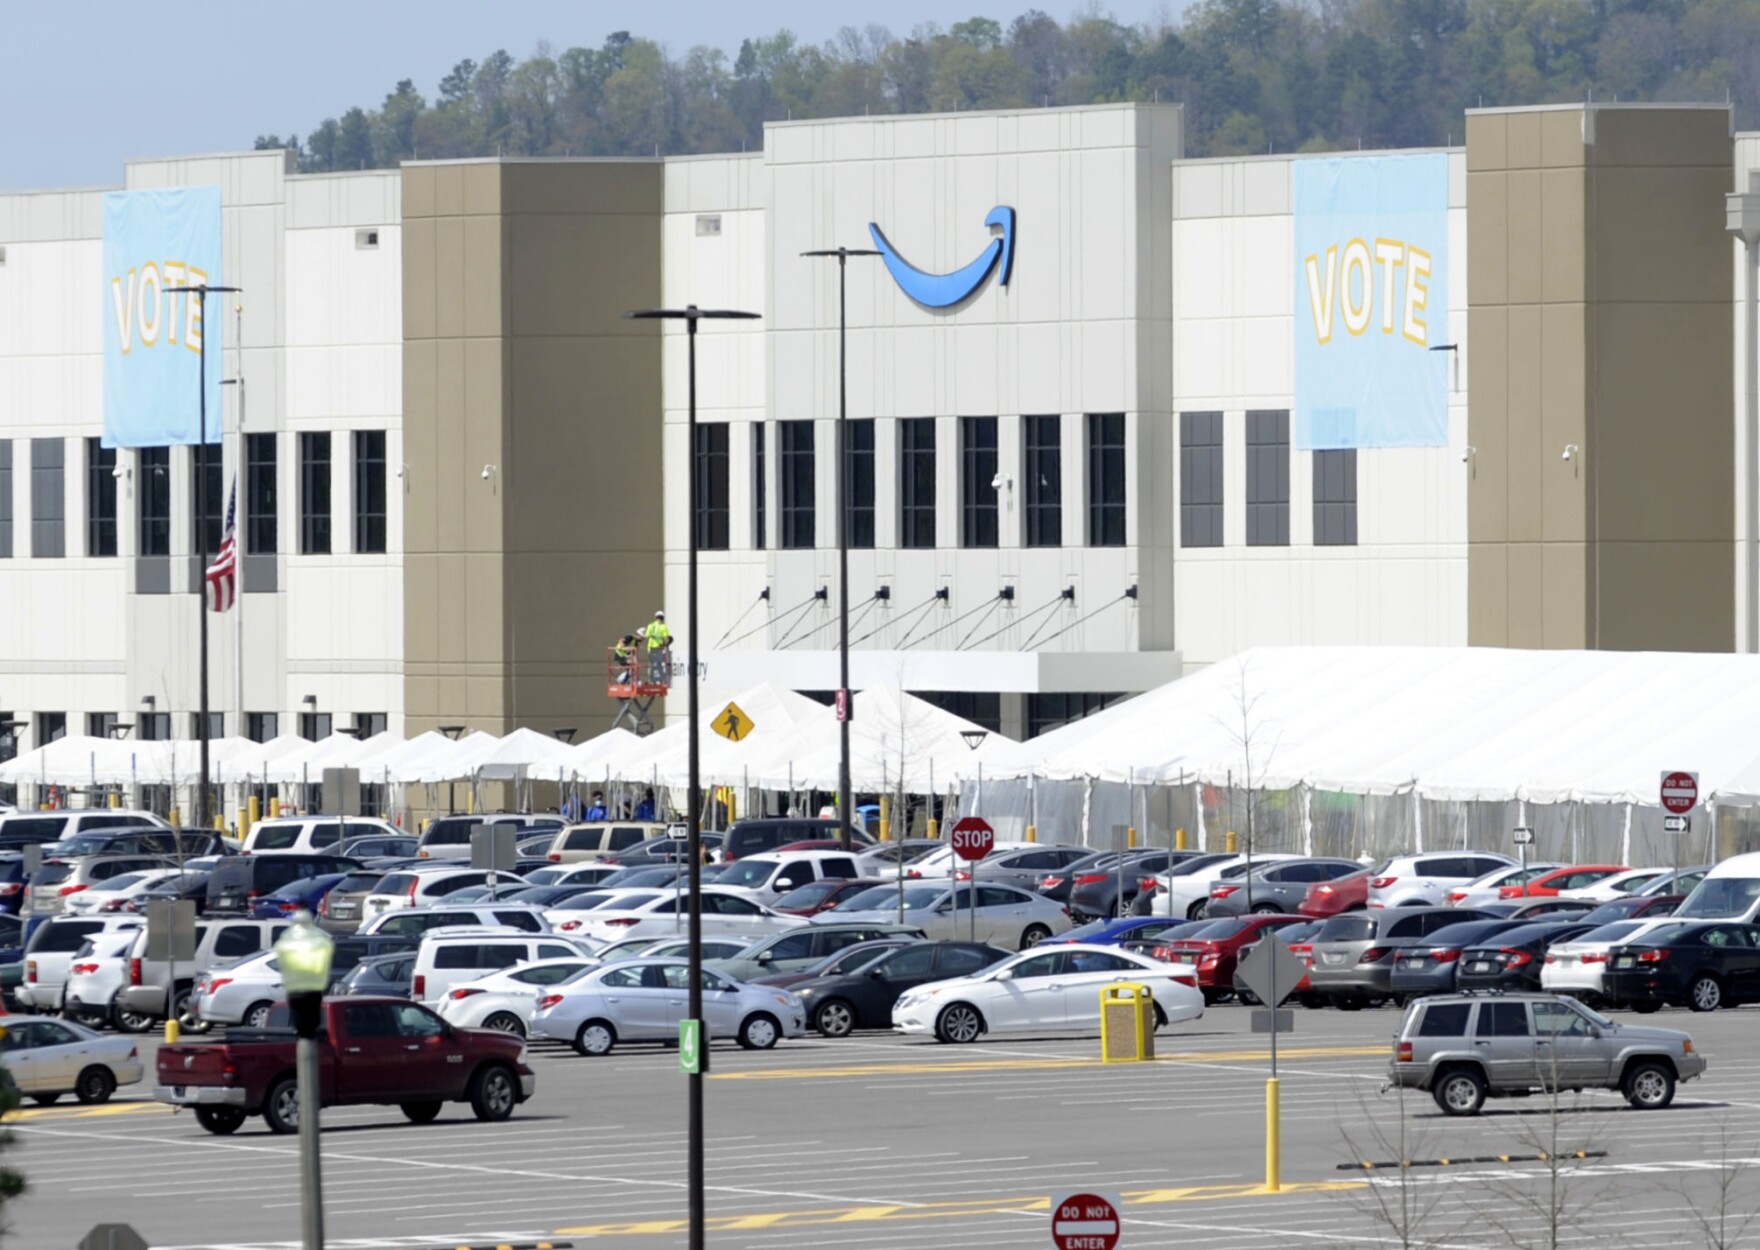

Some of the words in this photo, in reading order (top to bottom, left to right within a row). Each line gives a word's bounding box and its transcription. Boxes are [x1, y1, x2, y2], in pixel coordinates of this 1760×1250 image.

[1305, 236, 1432, 348] VOTE
[111, 260, 208, 356] VOTE
[953, 830, 992, 848] STOP
[683, 1024, 694, 1057] 4
[1062, 1206, 1080, 1219] DO
[1086, 1205, 1111, 1219] NOT
[1066, 1236, 1106, 1250] ENTER
